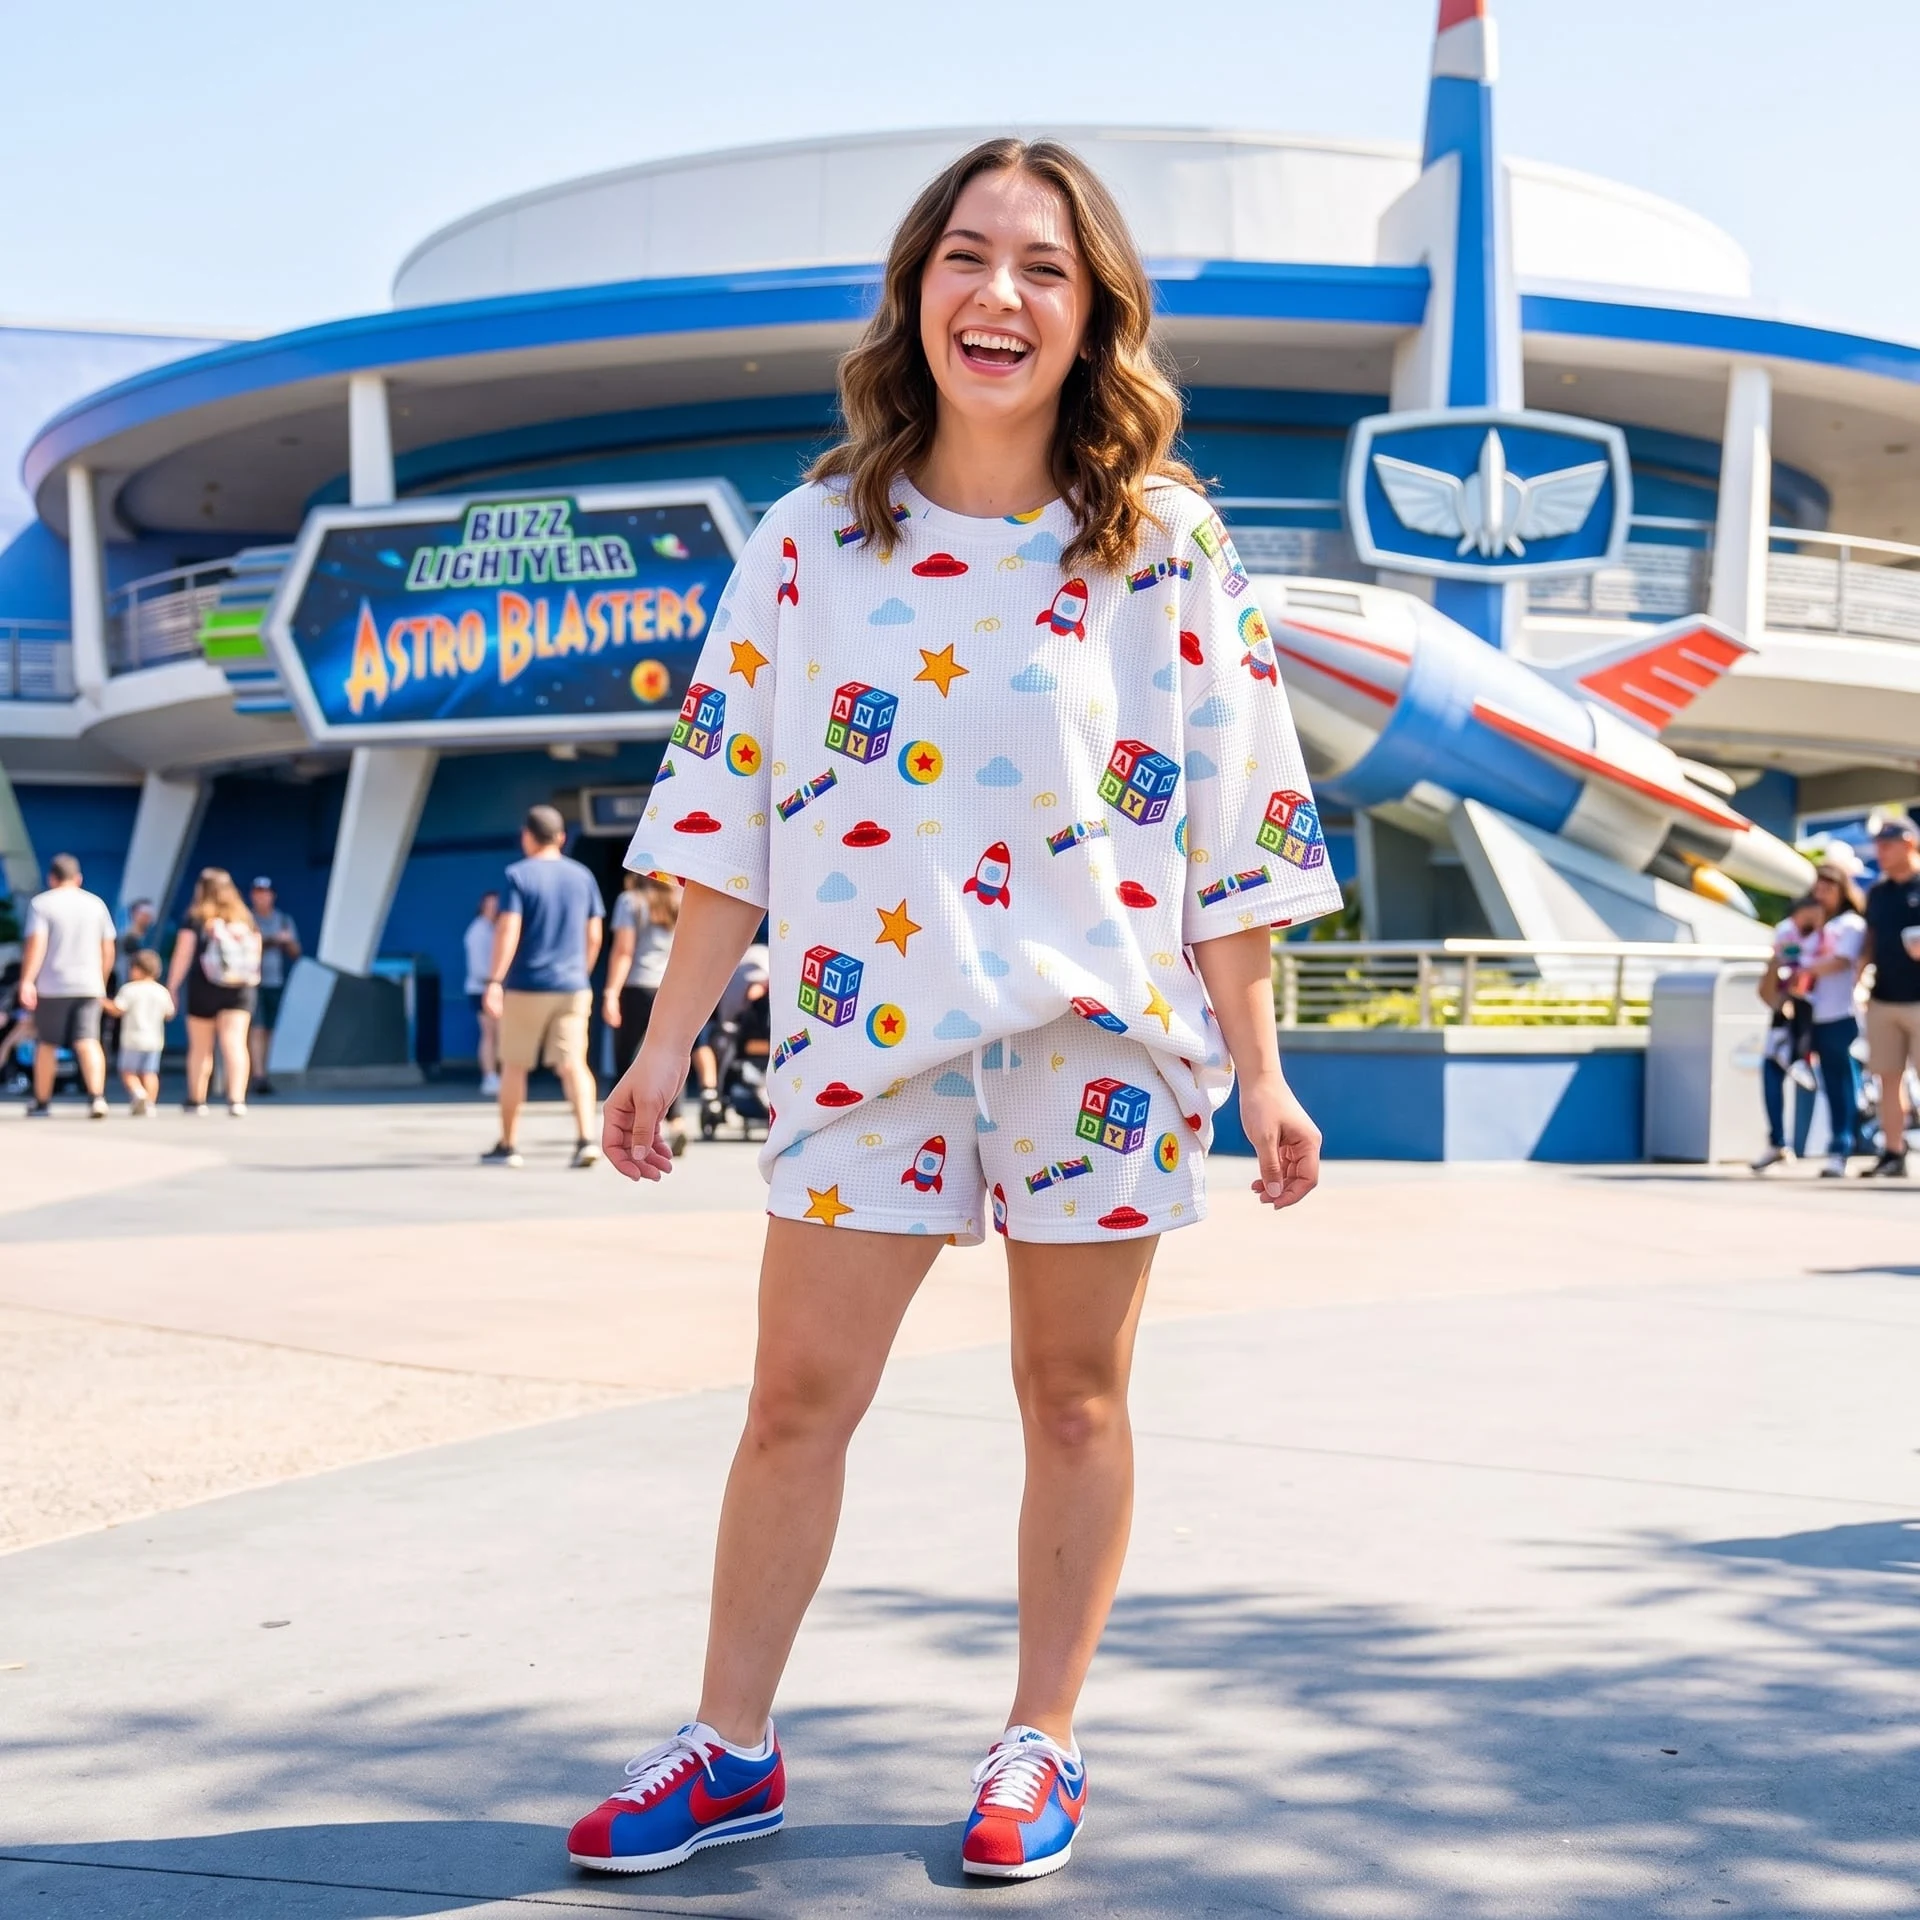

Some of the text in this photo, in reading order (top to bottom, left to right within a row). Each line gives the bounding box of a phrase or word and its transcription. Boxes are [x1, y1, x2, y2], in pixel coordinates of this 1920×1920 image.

[469, 506, 567, 543] BUZZ
[412, 541, 631, 586] LIGHTYEAR
[346, 582, 706, 715] ASTRO BLASTERS
